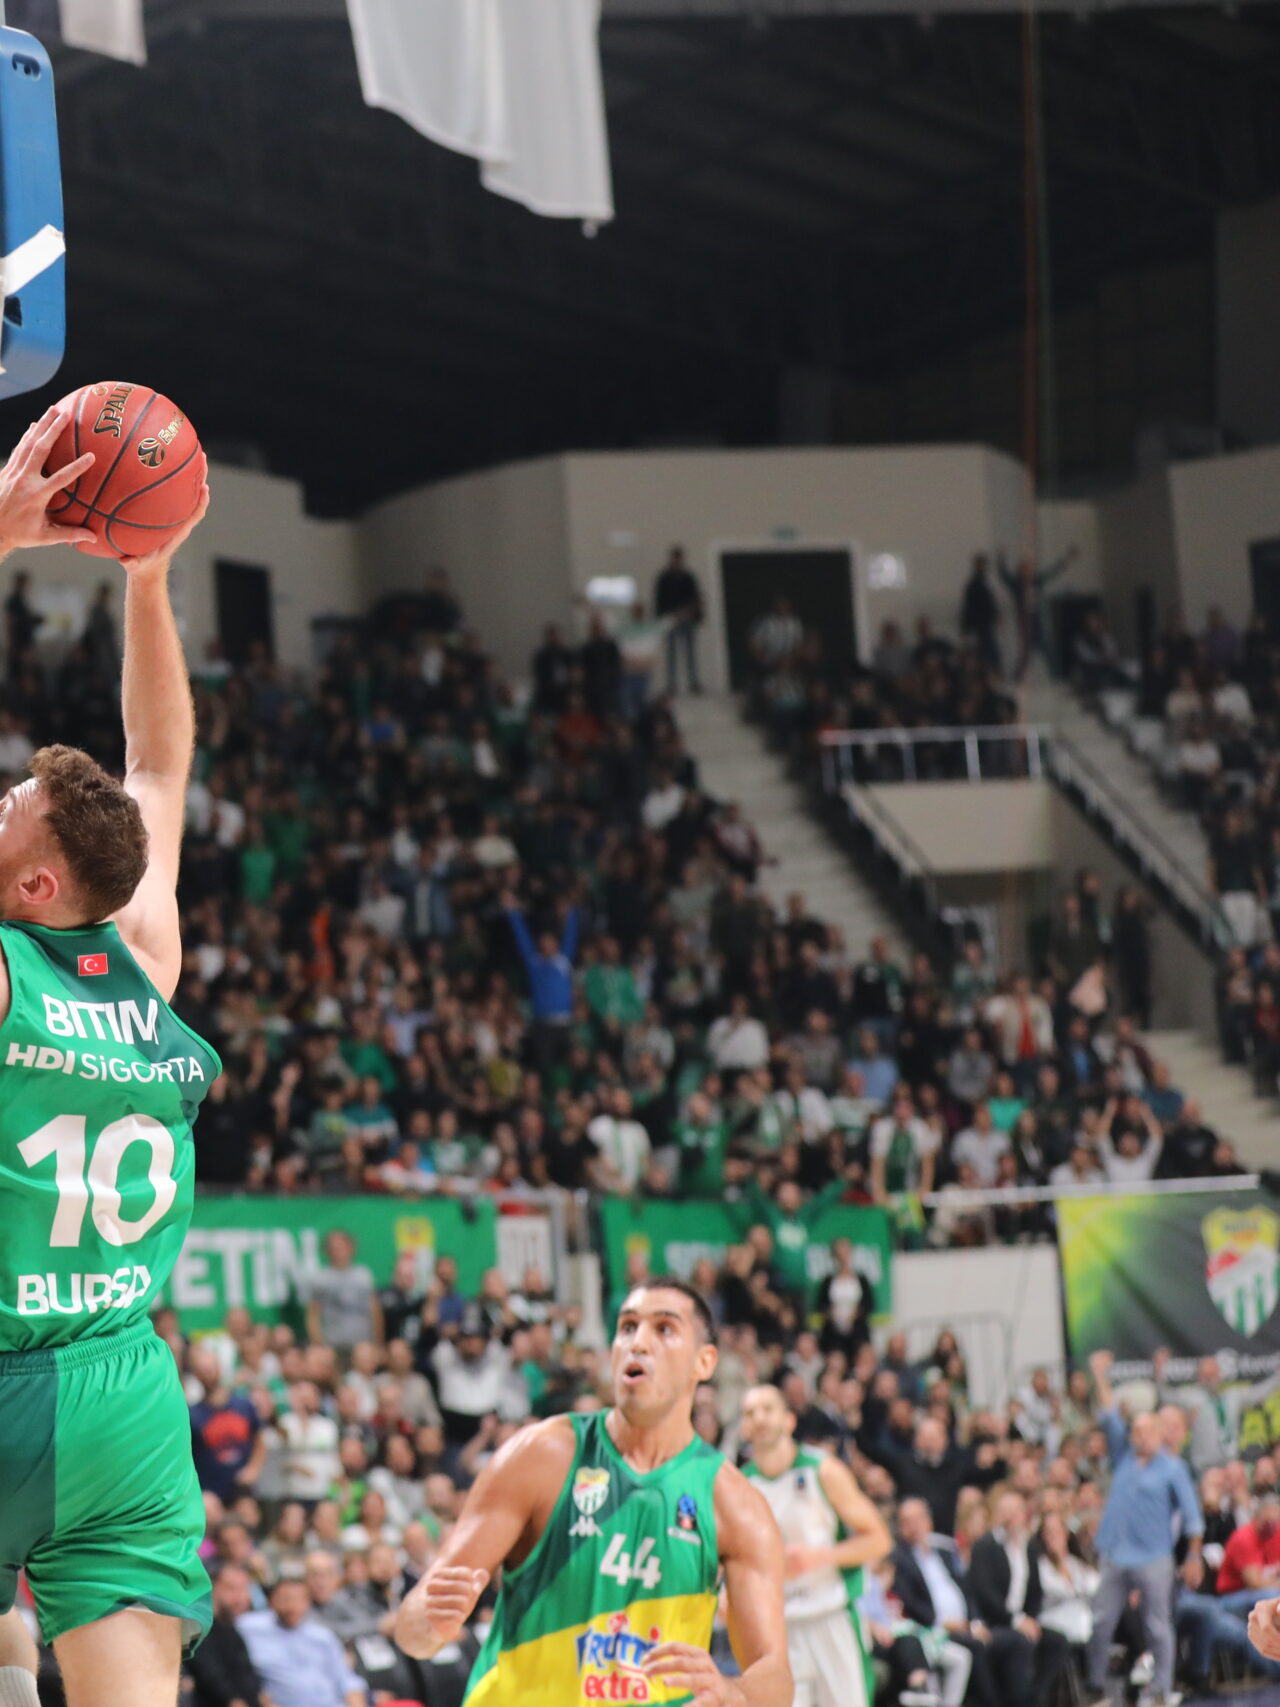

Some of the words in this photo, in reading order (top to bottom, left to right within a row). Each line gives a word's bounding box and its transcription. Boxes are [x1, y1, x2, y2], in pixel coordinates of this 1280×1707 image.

[5, 1042, 76, 1075] HDI
[17, 1113, 177, 1247] 10
[17, 1265, 152, 1315] BURSA
[600, 1532, 662, 1589] 44
